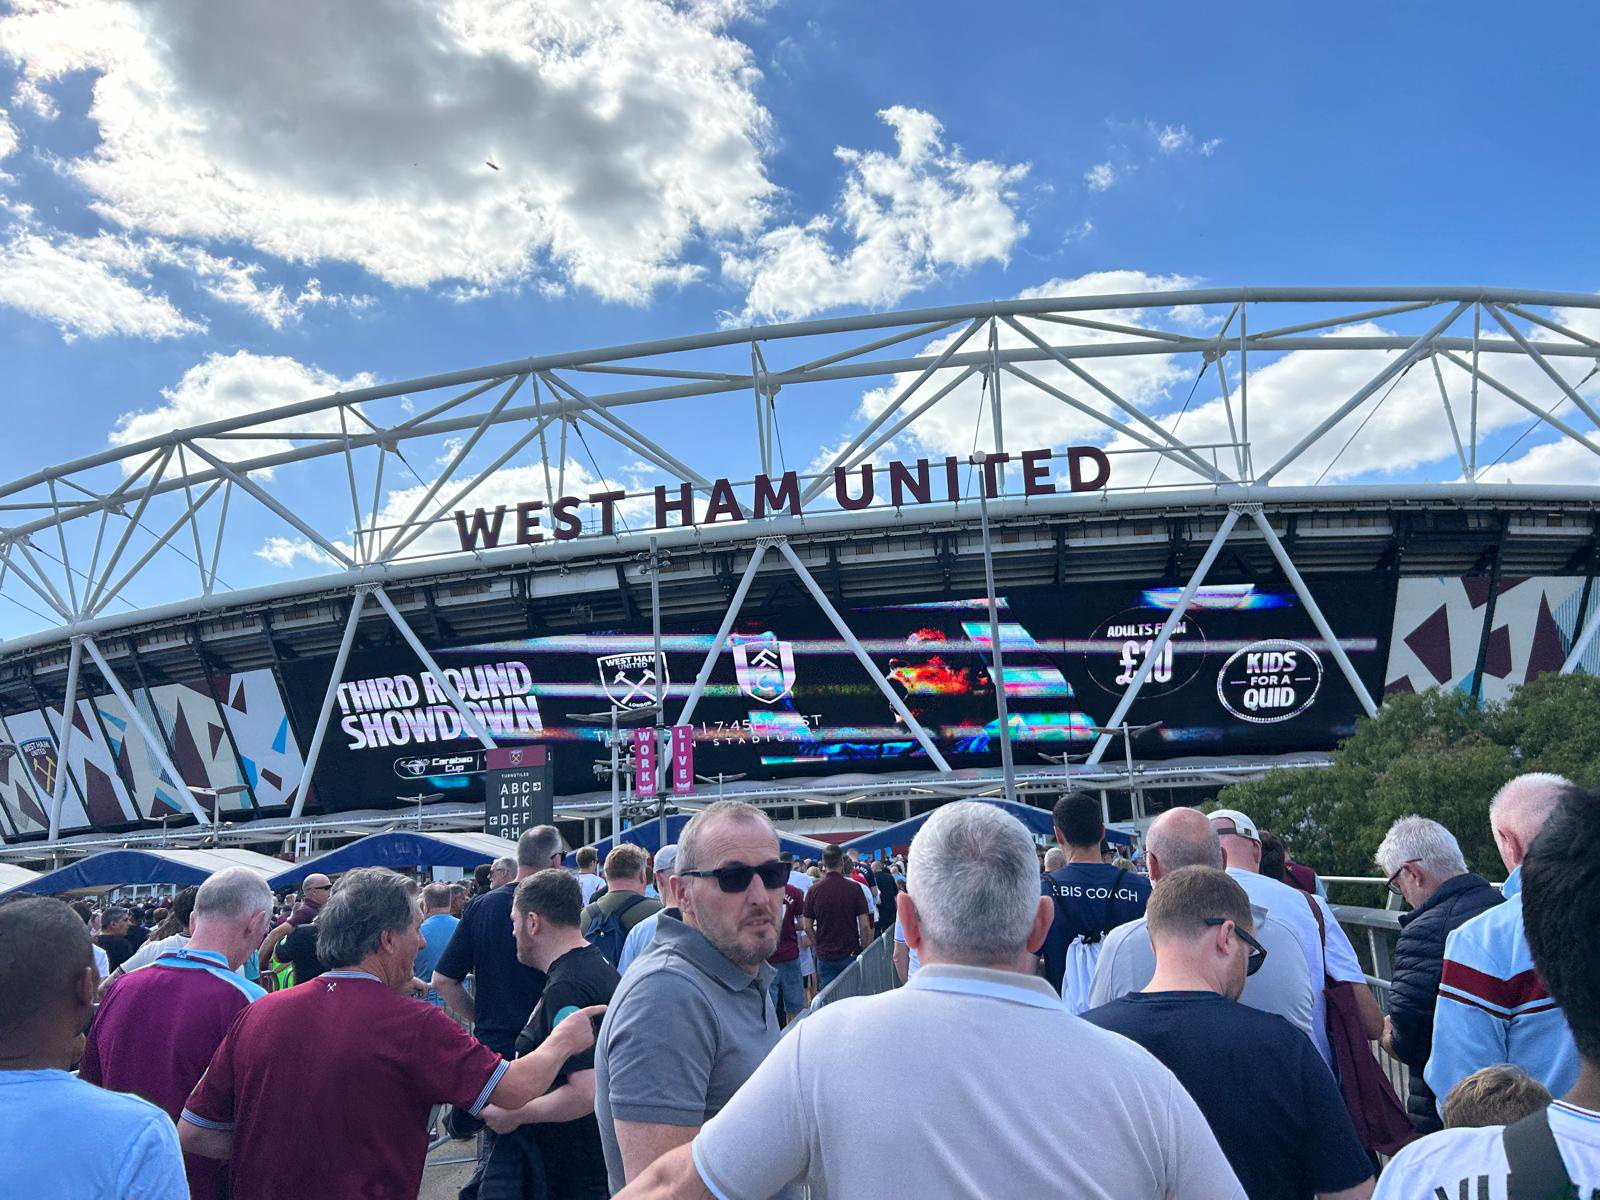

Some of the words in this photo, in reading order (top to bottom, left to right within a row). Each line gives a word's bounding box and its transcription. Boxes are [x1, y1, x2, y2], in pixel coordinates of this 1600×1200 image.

[454, 490, 625, 551] WEST
[654, 471, 802, 529] HAM
[834, 446, 1111, 510] UNITED
[1106, 624, 1153, 637] ADULTS
[605, 657, 632, 667] WEST
[617, 661, 648, 670] UNITED
[1246, 651, 1297, 674] KIDS
[336, 675, 419, 714] THIRD
[420, 661, 532, 704] ROUND
[1250, 675, 1279, 686] FOR
[1280, 674, 1291, 685] A
[1243, 686, 1295, 711] QUID
[341, 695, 544, 750] SHOWDOWN
[713, 734, 801, 746] STADIUM
[431, 756, 473, 766] Carabao
[638, 731, 651, 782] WORK
[678, 728, 688, 779] LIVE
[444, 764, 465, 773] Cup
